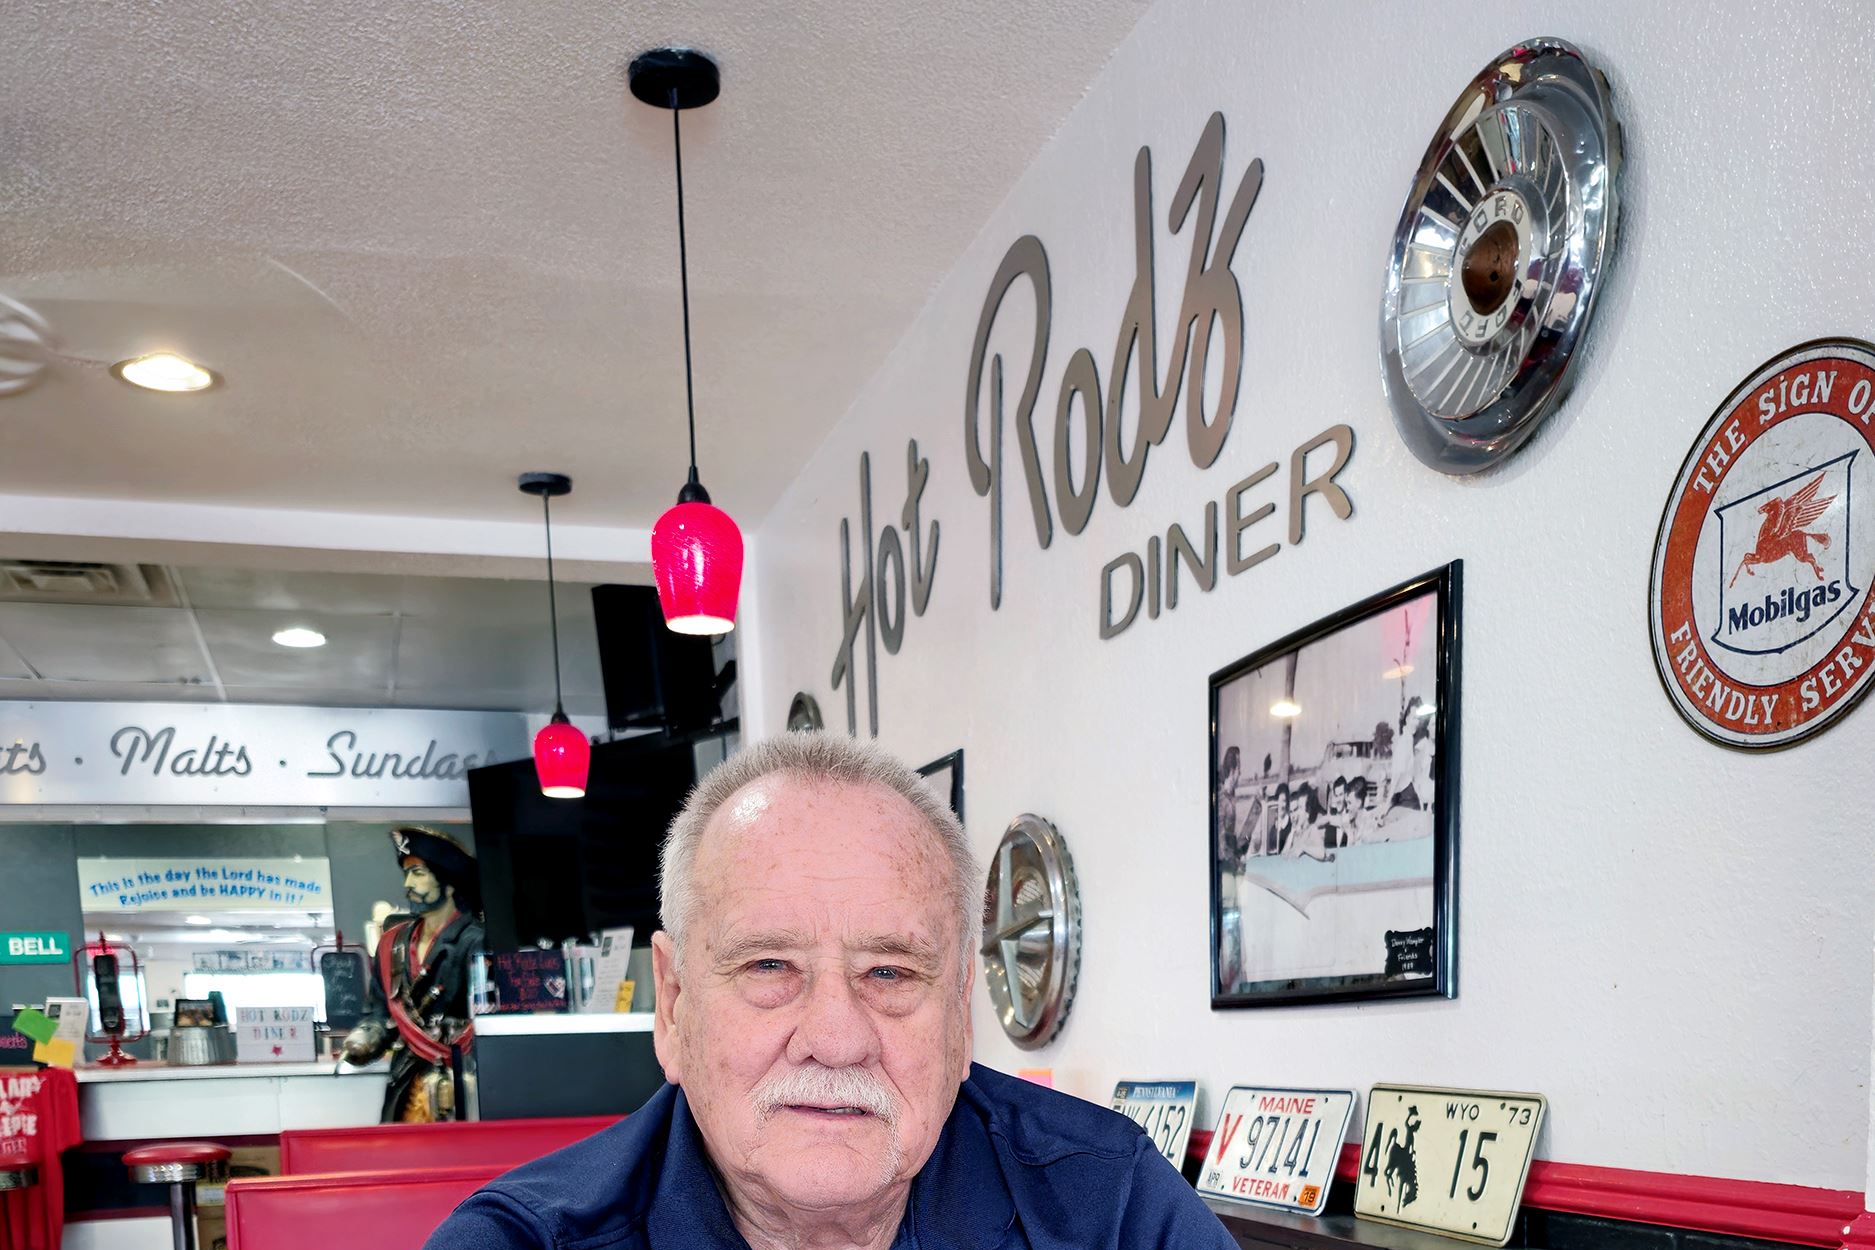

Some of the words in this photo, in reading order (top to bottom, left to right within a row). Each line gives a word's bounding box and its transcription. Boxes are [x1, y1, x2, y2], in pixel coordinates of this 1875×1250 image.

[1693, 418, 1750, 496] THE
[1758, 369, 1838, 425] SIGN
[1099, 424, 1356, 640] DINER
[831, 438, 939, 736] Hot
[1728, 578, 1842, 635] Mobilgas
[1671, 620, 1779, 726] FRIENDLY
[1800, 595, 1875, 712] SERV
[0, 743, 47, 776] ts
[110, 726, 253, 777] Malts
[89, 881, 120, 897] This
[123, 877, 135, 888] is
[138, 869, 161, 886] the
[165, 867, 191, 884] day
[196, 867, 218, 881] the
[222, 866, 253, 882] Lord
[257, 870, 281, 886] has
[285, 877, 322, 895] made
[119, 888, 168, 908] Rejoice
[172, 884, 197, 899] and
[200, 884, 216, 898] be
[219, 884, 266, 899] HAPPY
[269, 888, 283, 903] in
[8, 936, 63, 956] BELL
[1259, 1096, 1316, 1115] MAINE
[1446, 1102, 1480, 1121] WYO
[1216, 1112, 1243, 1166] V
[1240, 1116, 1322, 1178] 97141
[1364, 1122, 1384, 1188] 4
[1450, 1129, 1498, 1201] 15
[1232, 1176, 1290, 1201] VETERAN
